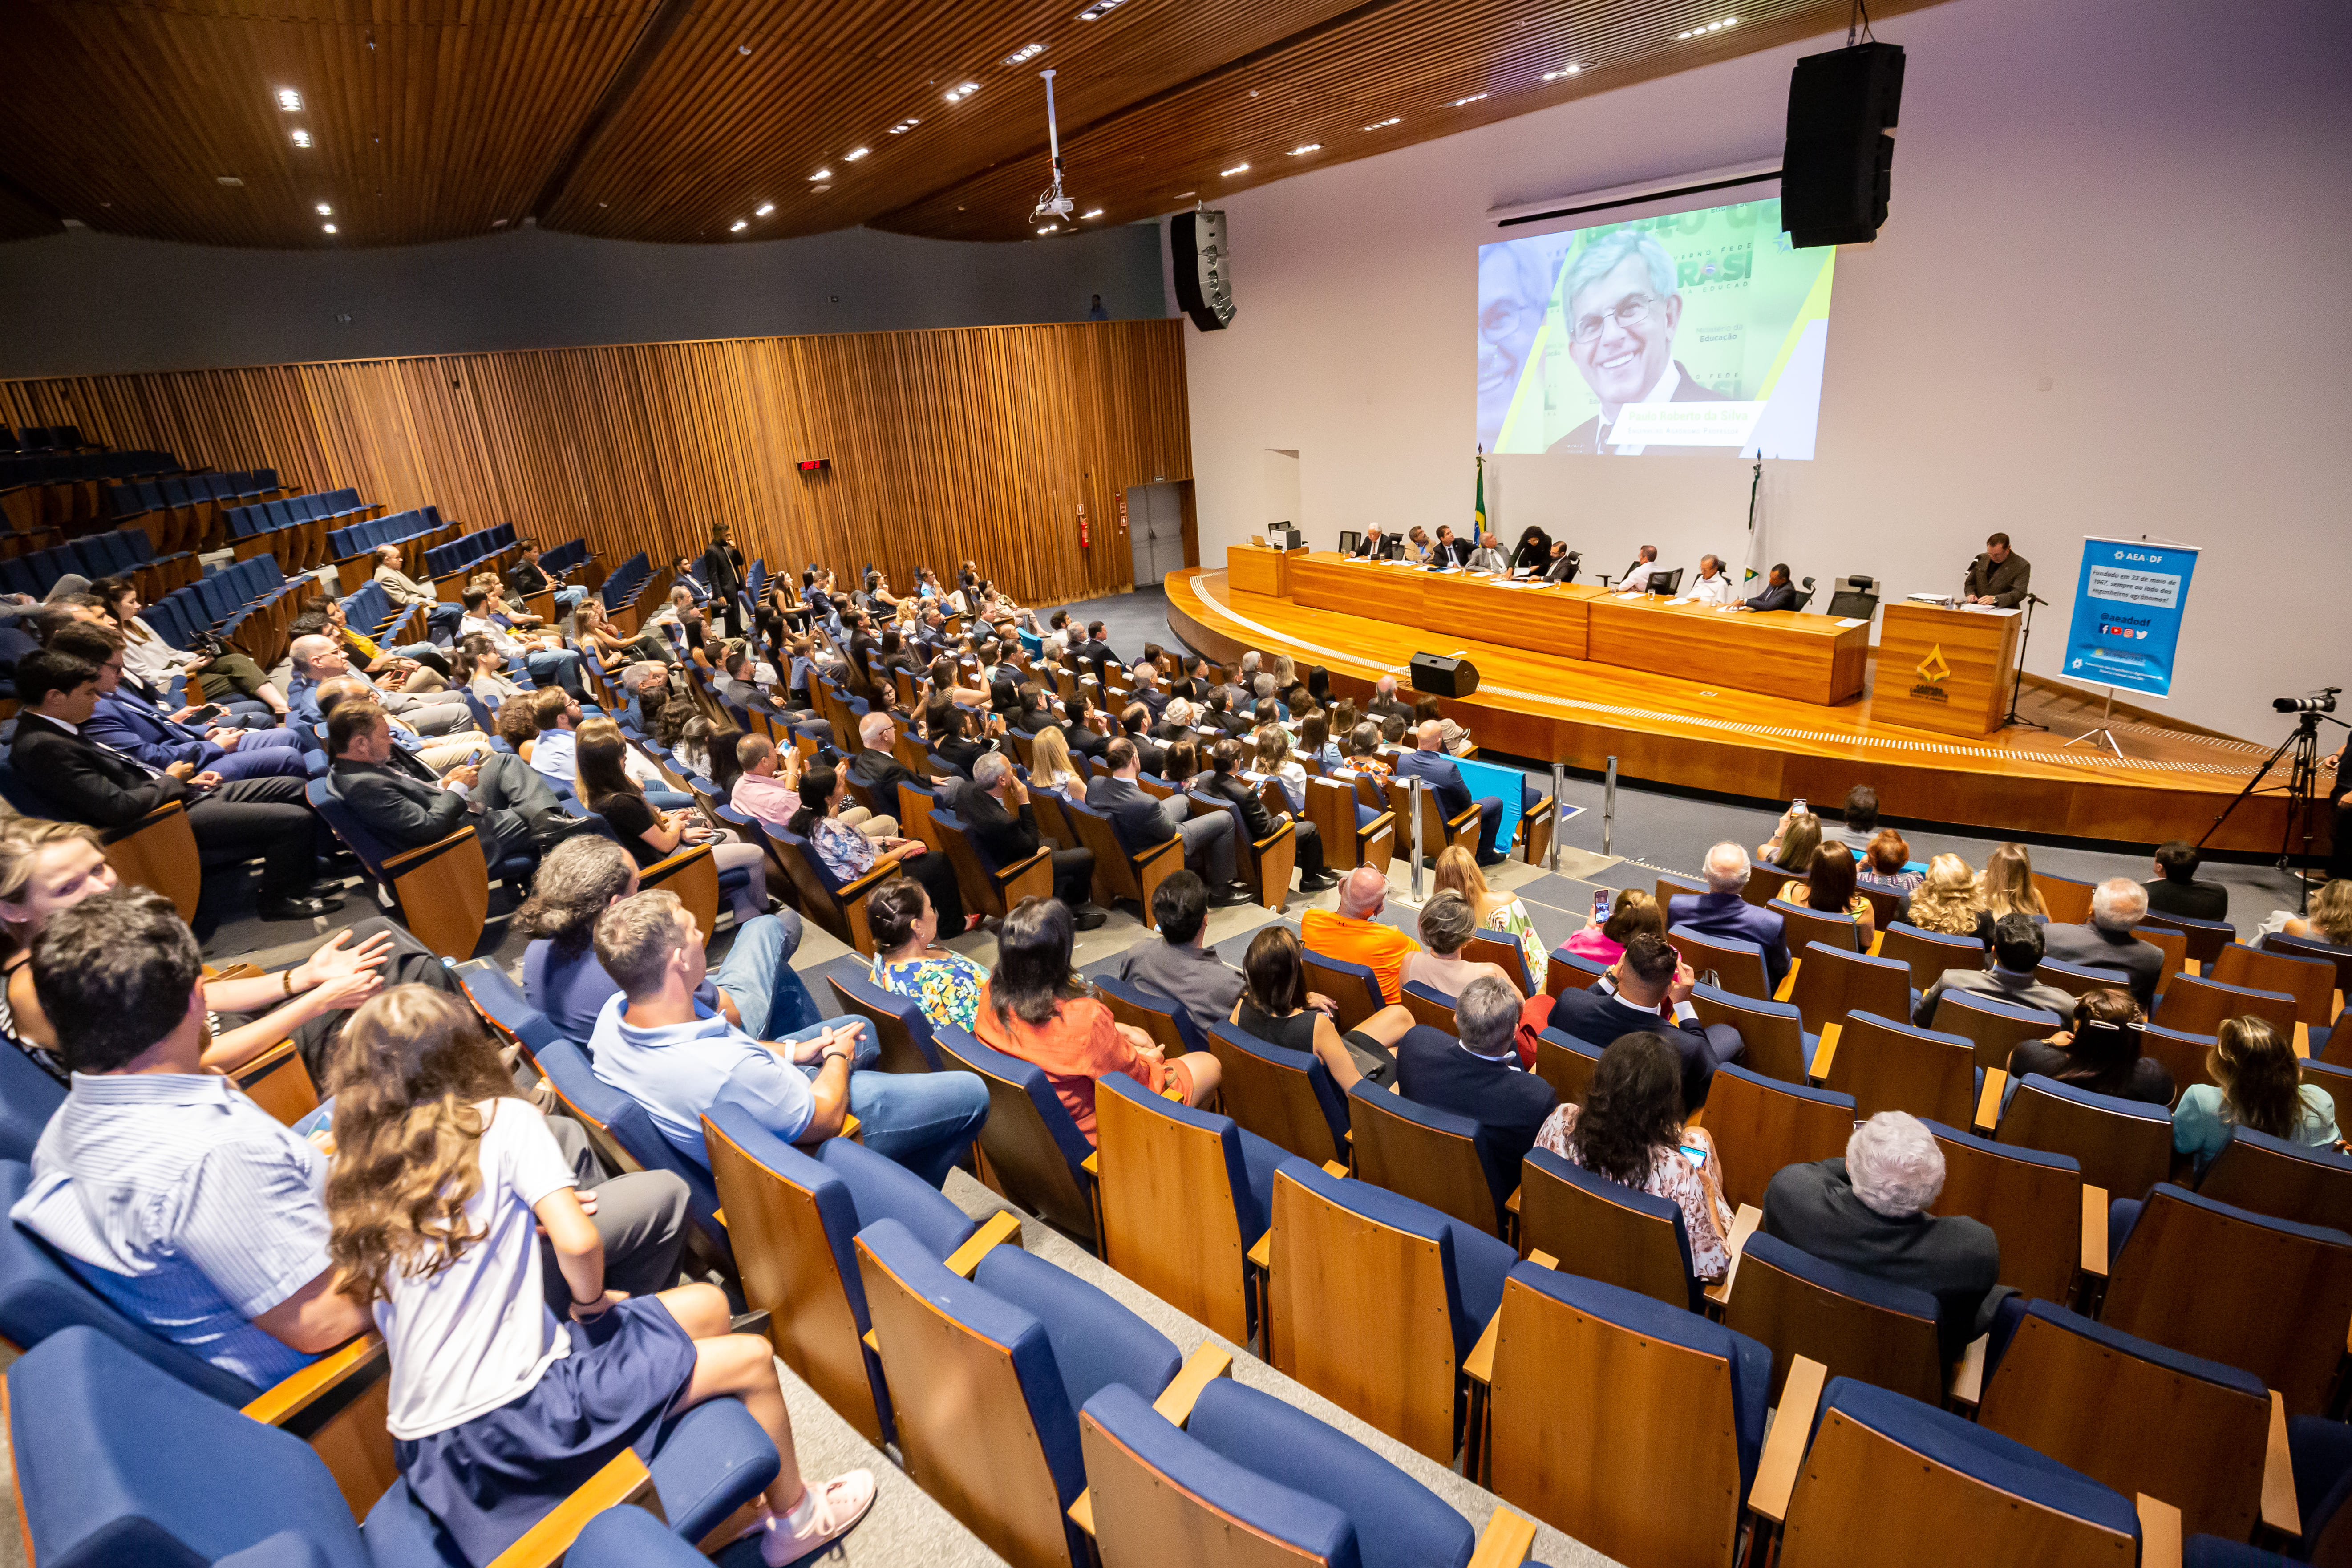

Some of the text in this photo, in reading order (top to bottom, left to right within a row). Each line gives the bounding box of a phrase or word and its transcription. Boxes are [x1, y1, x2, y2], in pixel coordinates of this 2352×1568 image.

[1700, 333, 1737, 342] Educação
[1629, 409, 1749, 421] Paulo Roberto da Silva
[2126, 553, 2163, 563] AEA-DF
[2092, 588, 2129, 597] engenheiros
[2100, 612, 2152, 627] @aeadodf
